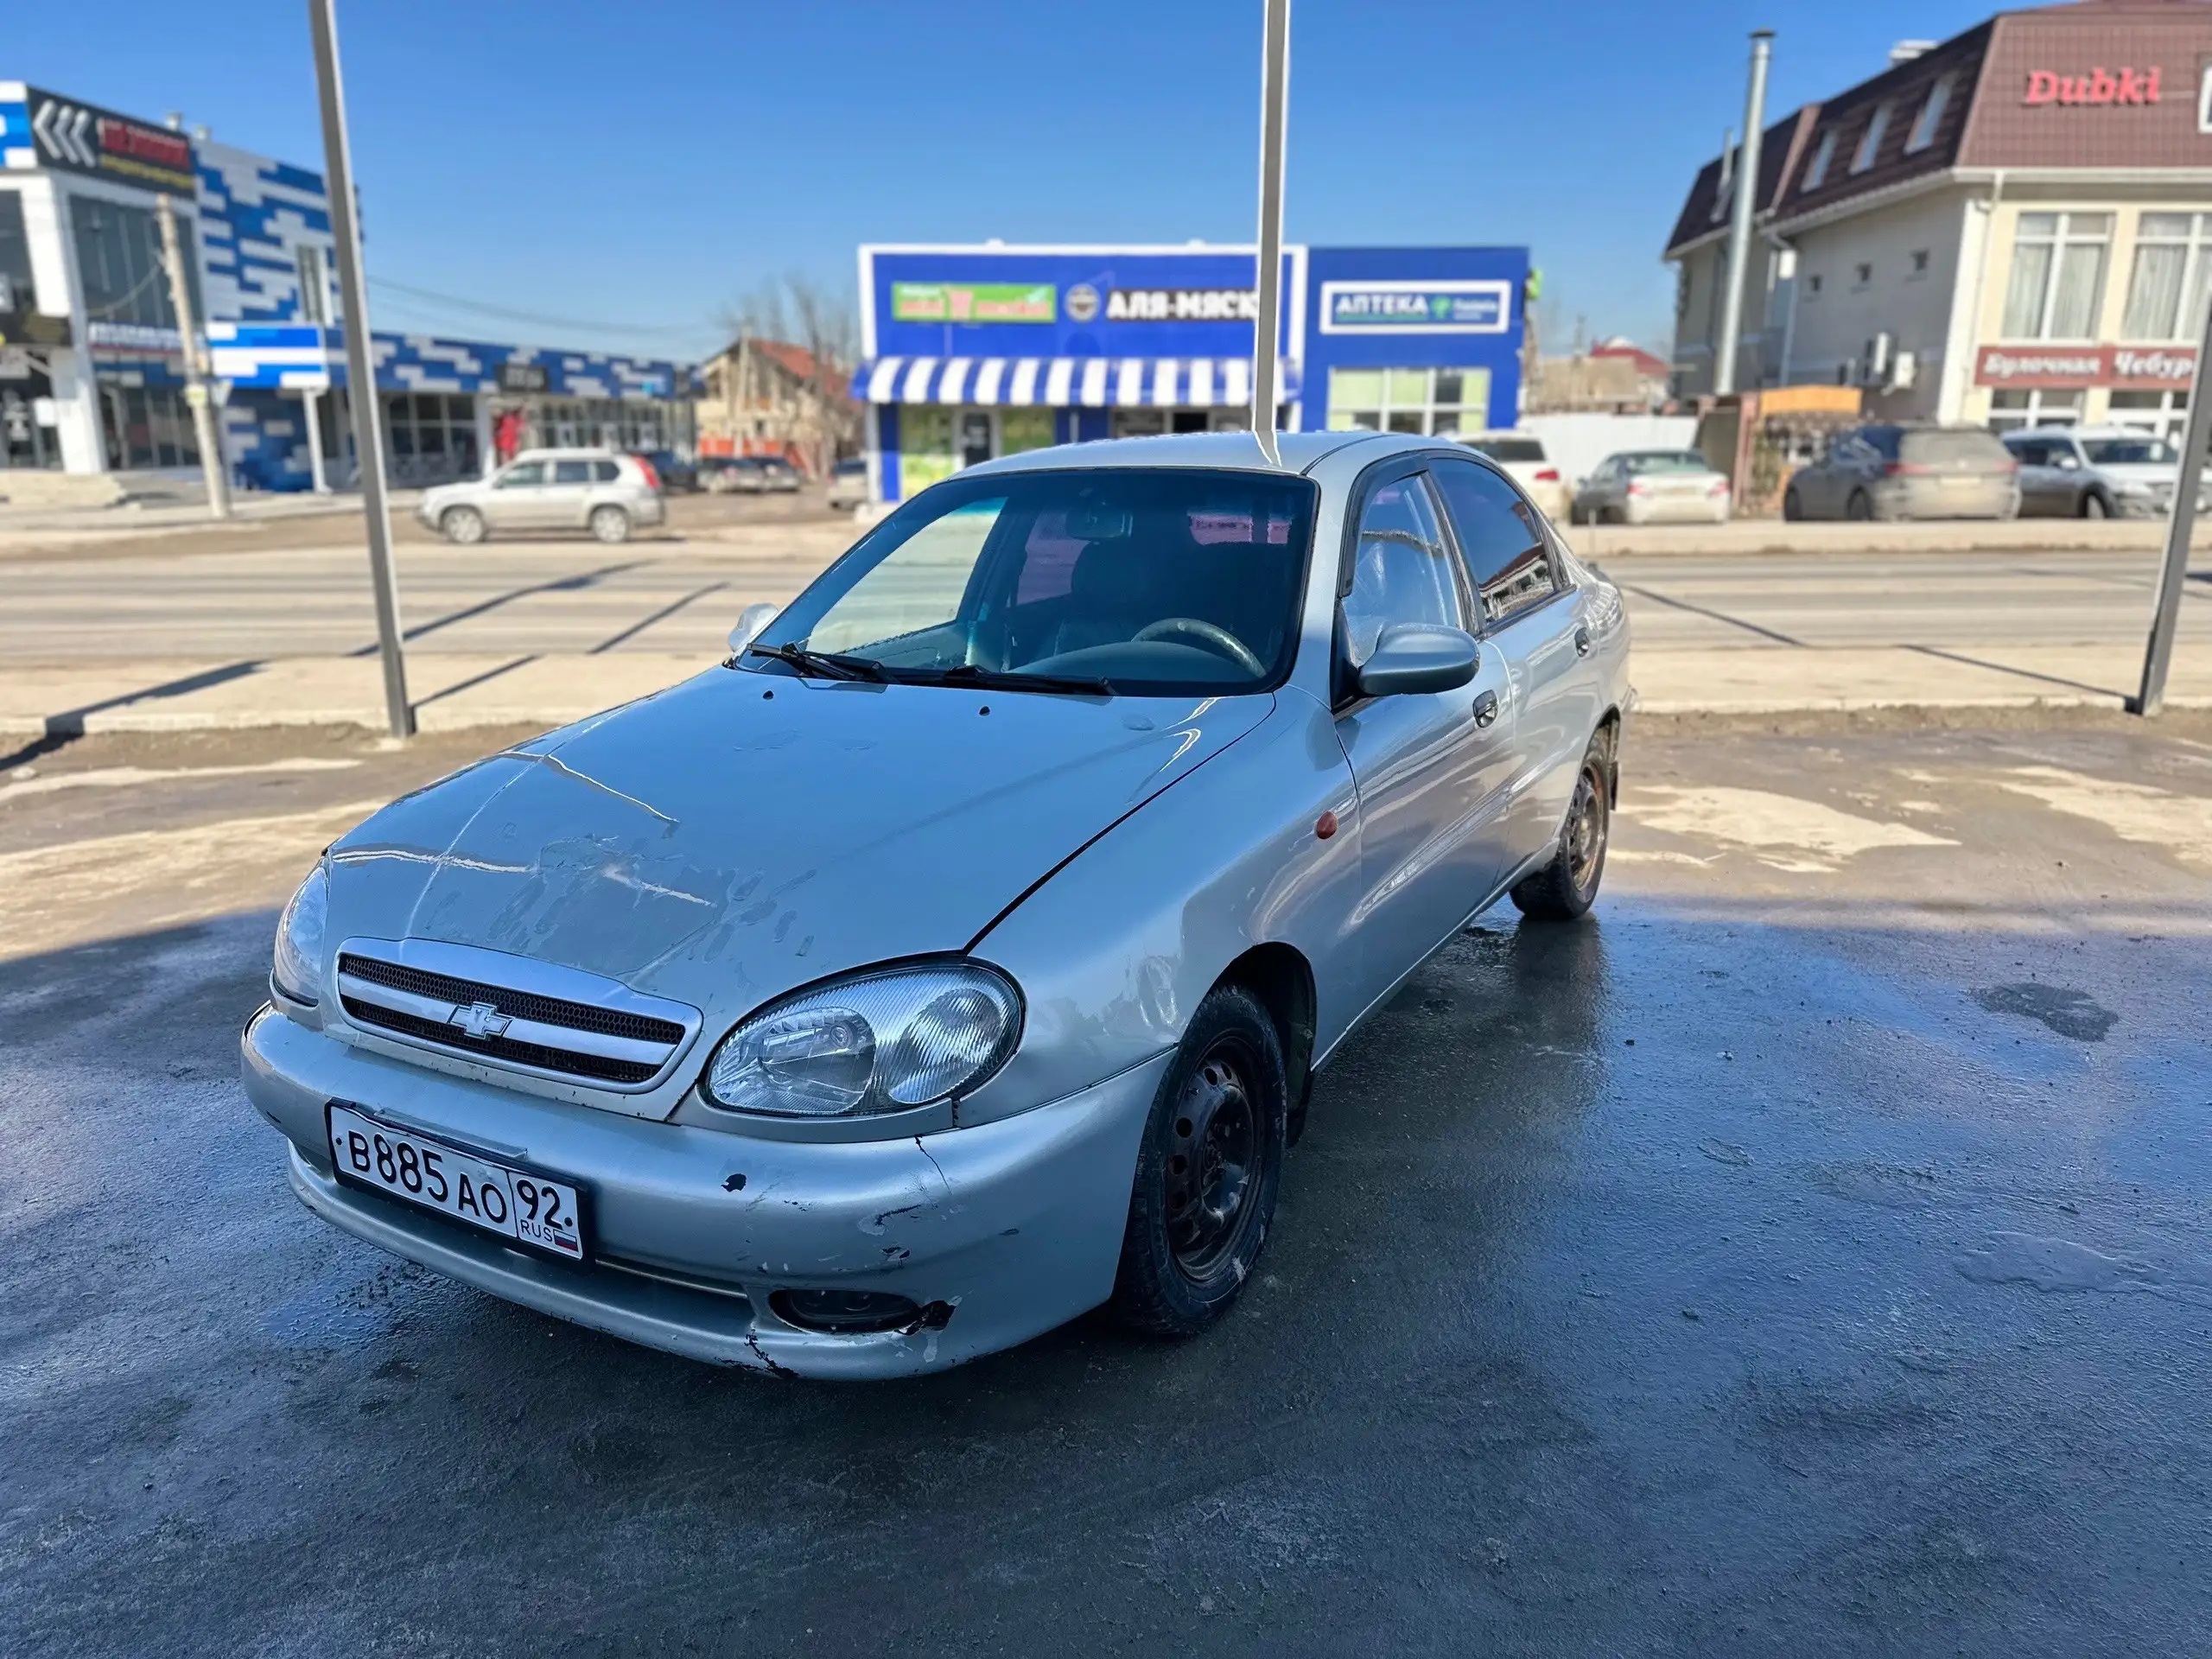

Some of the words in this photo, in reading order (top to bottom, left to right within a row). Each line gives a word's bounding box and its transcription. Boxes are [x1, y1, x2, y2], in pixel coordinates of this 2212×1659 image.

[2026, 66, 2160, 104] Dubki
[1335, 296, 1428, 315] АПТЕКА
[516, 1179, 564, 1231] 92
[519, 1218, 553, 1242] RUS
